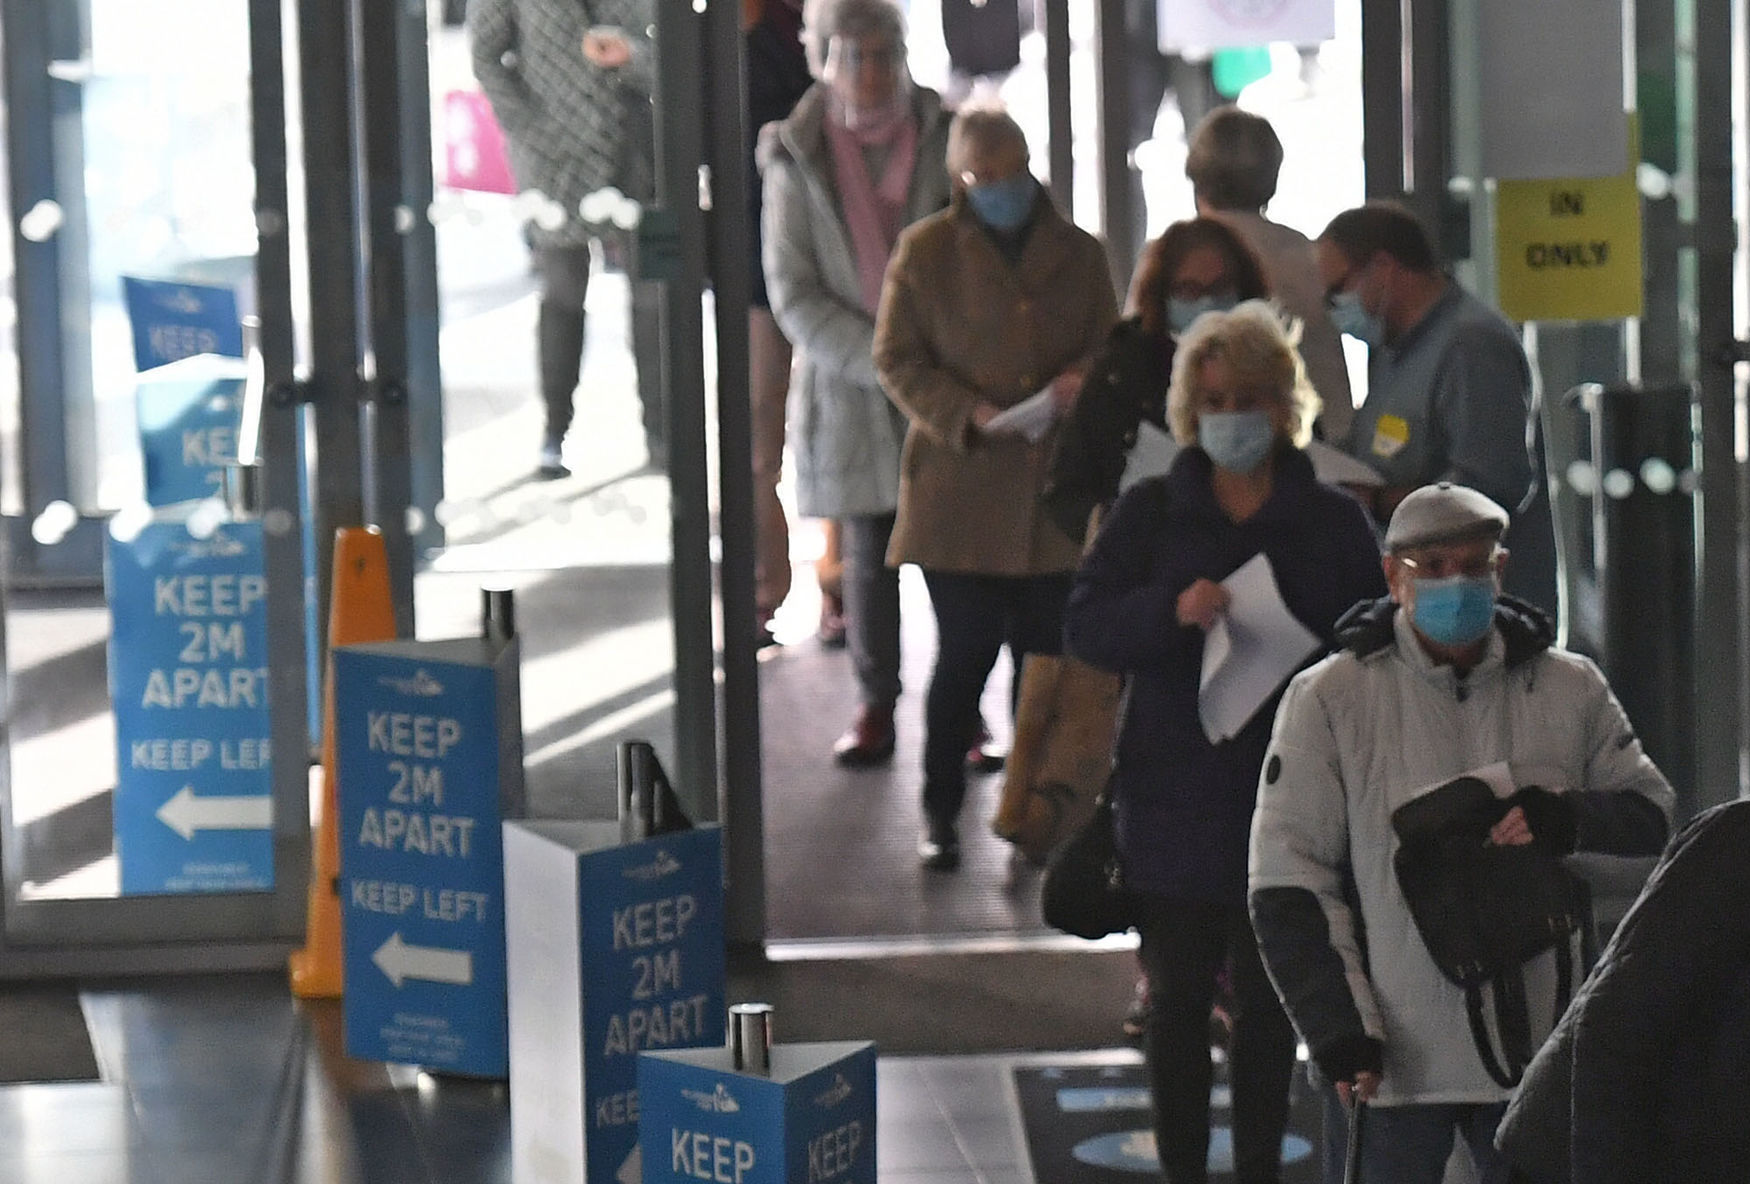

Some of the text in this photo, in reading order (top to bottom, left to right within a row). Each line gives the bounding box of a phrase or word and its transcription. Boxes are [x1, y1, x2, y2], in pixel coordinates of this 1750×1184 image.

[1550, 191, 1584, 216] IN
[1526, 242, 1609, 270] ONLY
[155, 575, 268, 616] KEEP
[179, 621, 246, 663] 2M
[131, 738, 272, 770] KEEP LEF
[367, 711, 462, 758] KEEP
[388, 761, 444, 807] 2M
[359, 806, 476, 857] APART
[352, 879, 488, 922] KEEP LEFT
[613, 895, 697, 949] KEEP
[632, 950, 680, 999] 2M
[604, 994, 708, 1056] APART
[808, 1120, 862, 1184] KEEP
